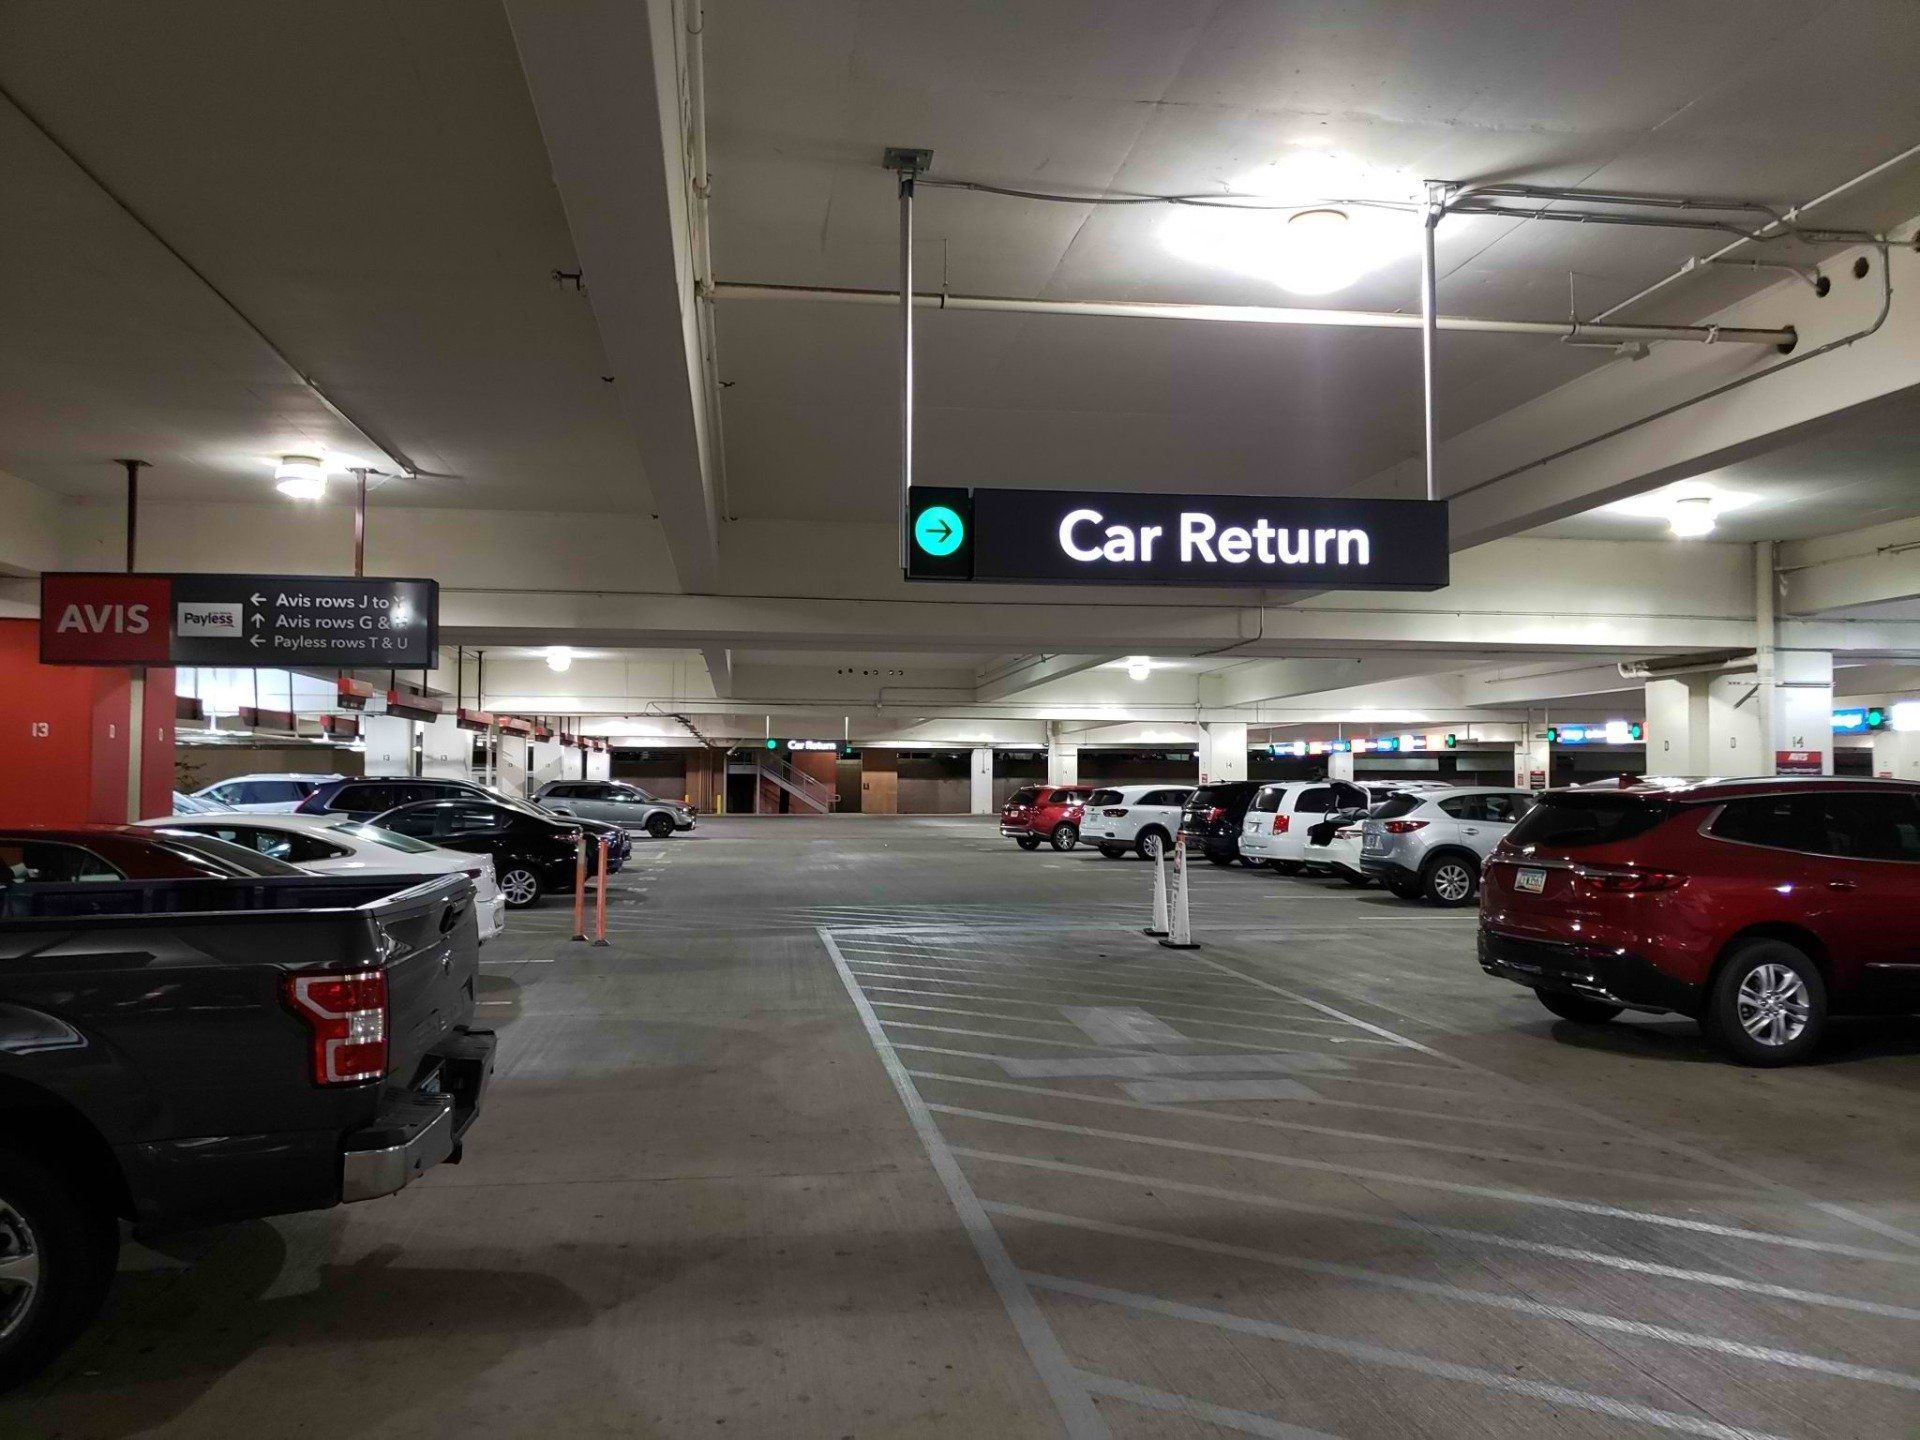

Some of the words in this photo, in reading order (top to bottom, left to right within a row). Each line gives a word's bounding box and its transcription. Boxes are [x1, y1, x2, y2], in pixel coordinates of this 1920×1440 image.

[1058, 508, 1163, 562] Car
[1179, 512, 1370, 565] Return
[275, 593, 311, 608] Avis
[315, 597, 355, 609] rows
[359, 595, 368, 609] J
[372, 596, 390, 609] to
[57, 603, 150, 634] AVIS
[183, 611, 234, 627] Payless
[275, 614, 311, 628] Avis
[315, 618, 355, 629] rows
[359, 616, 373, 629] G
[377, 617, 391, 630] &
[274, 635, 327, 650] Payless
[330, 638, 366, 649] rows
[369, 637, 379, 649] T
[382, 638, 393, 649] &
[397, 637, 408, 650] U
[32, 722, 49, 737] 13
[1792, 736, 1804, 748] 14
